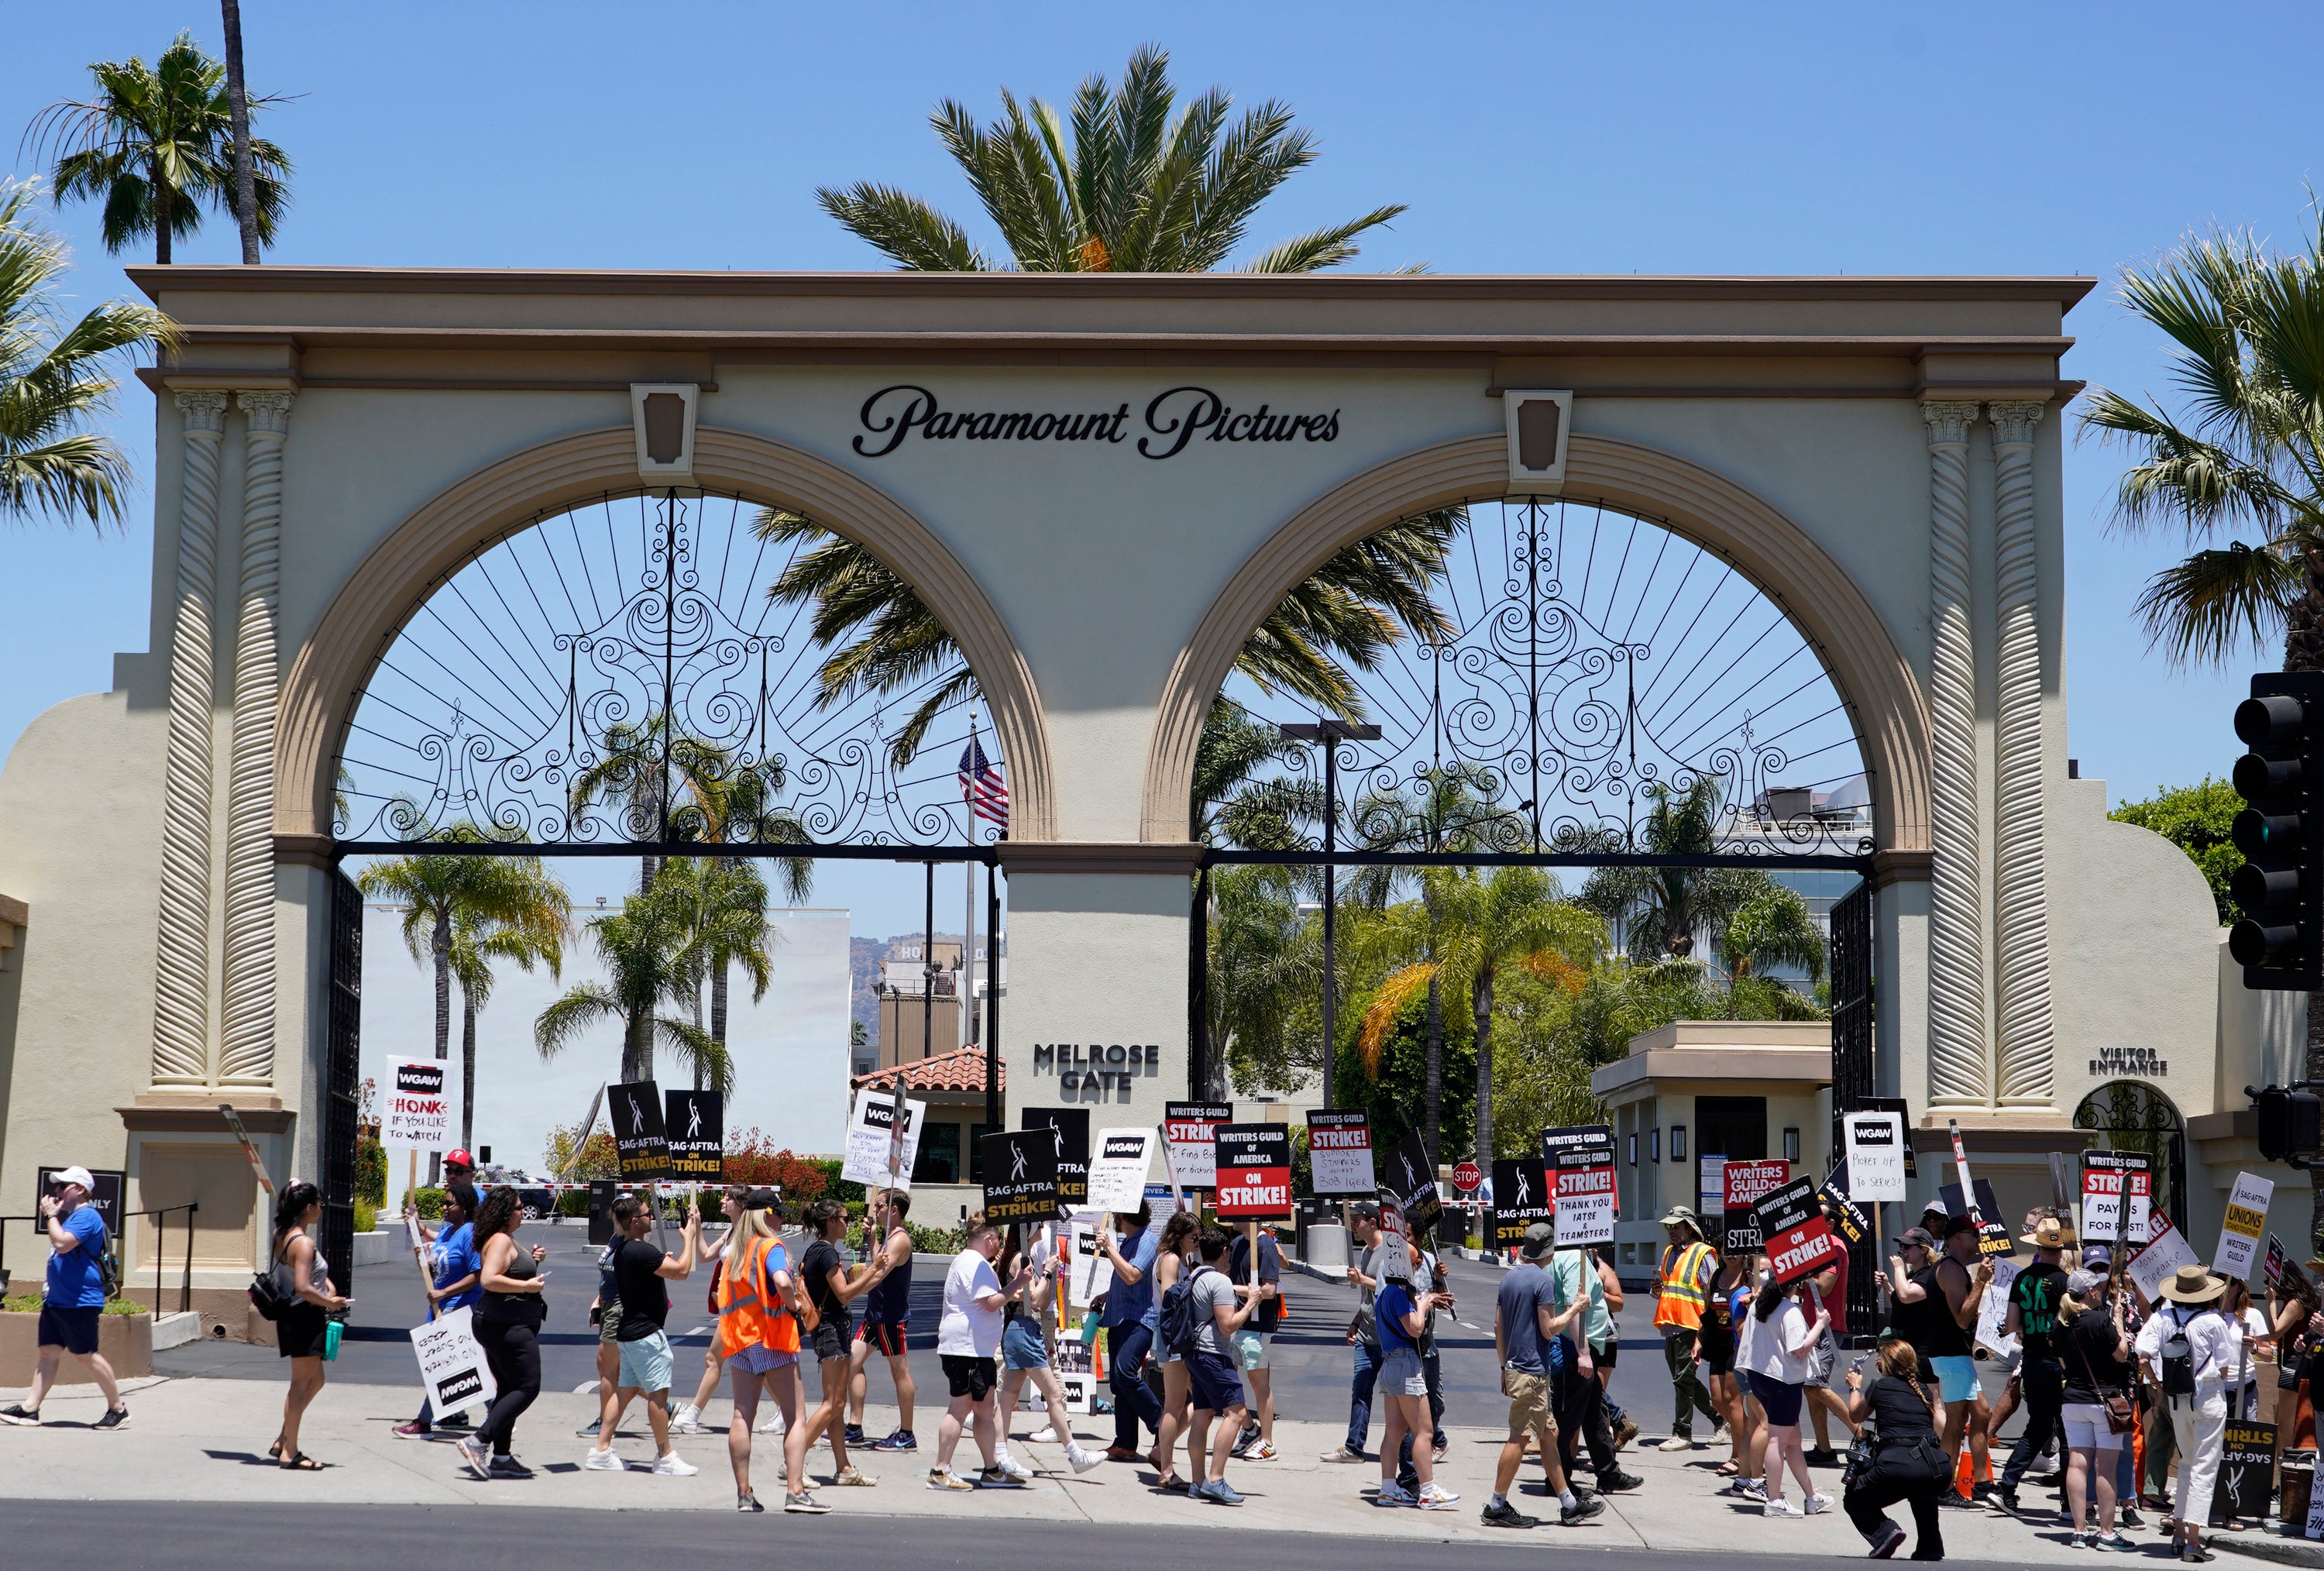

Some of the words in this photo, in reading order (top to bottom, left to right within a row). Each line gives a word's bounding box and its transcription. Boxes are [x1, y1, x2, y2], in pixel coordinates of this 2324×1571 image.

[852, 385, 1129, 457] Paramount
[1136, 387, 1341, 459] Pictures
[1033, 1043, 1159, 1064] MELROSE
[2099, 1047, 2157, 1059] VISITOR
[2089, 1060, 2168, 1072] ENTRANCE
[398, 1073, 442, 1086] WGAW
[1060, 1071, 1132, 1091] GATE
[395, 1098, 442, 1115] HONK
[1170, 1108, 1205, 1116] WRITERS
[1206, 1108, 1229, 1117] GUILD
[392, 1116, 403, 1126] IF
[405, 1115, 425, 1128] YOU
[427, 1116, 448, 1128] LIKE
[1311, 1115, 1343, 1124] WRITERS
[1343, 1114, 1364, 1122] GUILD
[406, 1130, 442, 1141] WATCH
[1169, 1123, 1215, 1140] STRIK
[1219, 1133, 1258, 1143] WRITERS
[1258, 1132, 1284, 1142] GUILD
[1855, 1128, 1892, 1139] WGAW
[1313, 1129, 1367, 1148] STRIKE!
[1546, 1134, 1583, 1146] WRITERS
[1583, 1133, 1607, 1143] GUILD
[1106, 1143, 1143, 1153] WGAW
[1247, 1144, 1257, 1153] OF
[1319, 1150, 1357, 1159] SUPPORT
[622, 1155, 671, 1172] STRIKE!
[854, 1152, 877, 1164] FONDA
[1233, 1154, 1272, 1164] AMERICA
[1321, 1159, 1361, 1169] STAFFERS
[1559, 1154, 1591, 1165] WRITERS
[1591, 1152, 1611, 1163] GUILD
[1883, 1156, 1896, 1167] UP
[2088, 1156, 2125, 1167] WRITERS
[2125, 1158, 2147, 1168] GUILD
[1246, 1173, 1262, 1184] ON
[1454, 1171, 1479, 1183] STOP
[1728, 1166, 1783, 1180] WRITERS
[1318, 1176, 1341, 1188] BOB
[1346, 1177, 1370, 1189] IGER
[1559, 1171, 1611, 1194] STRIKE!
[1731, 1179, 1769, 1191] GUILD
[1870, 1176, 1901, 1188] SERIES!
[1220, 1185, 1287, 1206] STRIKE!
[1757, 1195, 1790, 1215] WRITERS
[1789, 1184, 1810, 1201] GUILD
[88, 1199, 112, 1209] NLY
[988, 1199, 1056, 1218] STRIKE!
[1560, 1201, 1589, 1211] THANK
[1592, 1198, 1610, 1208] YOU
[1783, 1205, 1792, 1215] OF
[2097, 1204, 2119, 1215] PAY
[1573, 1212, 1597, 1222] IATSE
[1839, 1205, 1850, 1217] ON
[2228, 1205, 2263, 1229] UNIONS
[1775, 1209, 1808, 1232] AMERICA
[2089, 1221, 2112, 1231] FOR
[1560, 1228, 1609, 1241] TEAMSTERS
[2226, 1222, 2240, 1232] STAND
[2240, 1226, 2258, 1237] TOGETHER
[1790, 1230, 1805, 1245] ON
[2226, 1238, 2251, 1253] WRITERS
[1774, 1233, 1832, 1274] STRIKE!
[2137, 1243, 2166, 1271] MONEY
[2227, 1251, 2245, 1263] GUILD
[1978, 1323, 2010, 1350] WRITERS
[441, 1375, 480, 1400] WGAW
[2223, 1429, 2274, 1445] STRIK
